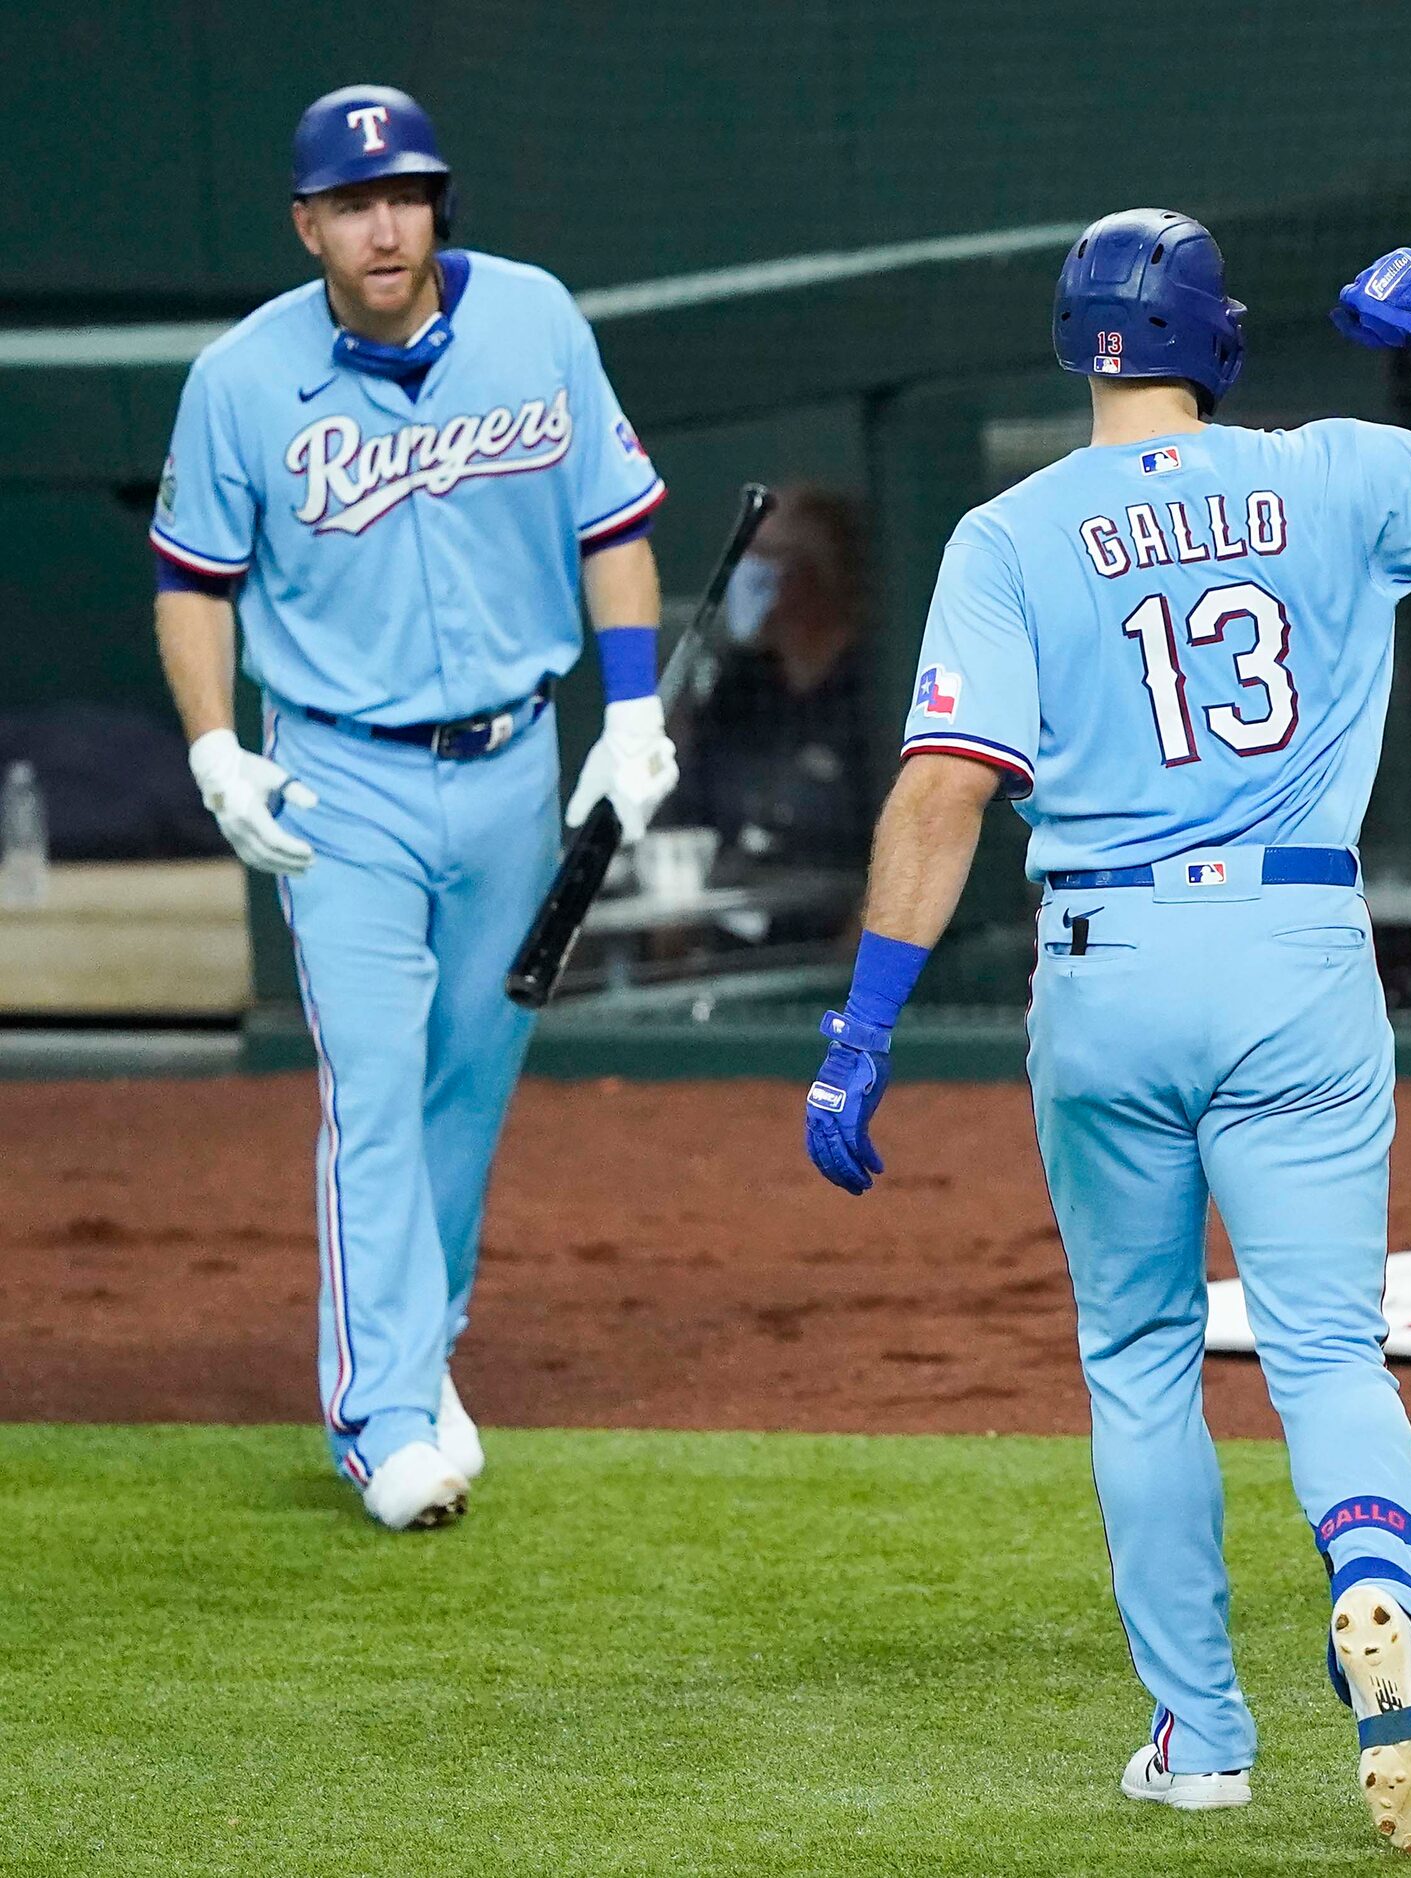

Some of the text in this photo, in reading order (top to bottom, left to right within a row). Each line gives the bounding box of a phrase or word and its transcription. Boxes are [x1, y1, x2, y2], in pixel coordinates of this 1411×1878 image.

[346, 106, 390, 156] T
[1097, 331, 1123, 355] 13
[284, 387, 573, 536] Rangers
[1079, 490, 1287, 579] GALLO
[1121, 580, 1299, 768] 13
[1320, 1503, 1406, 1541] GALLO
